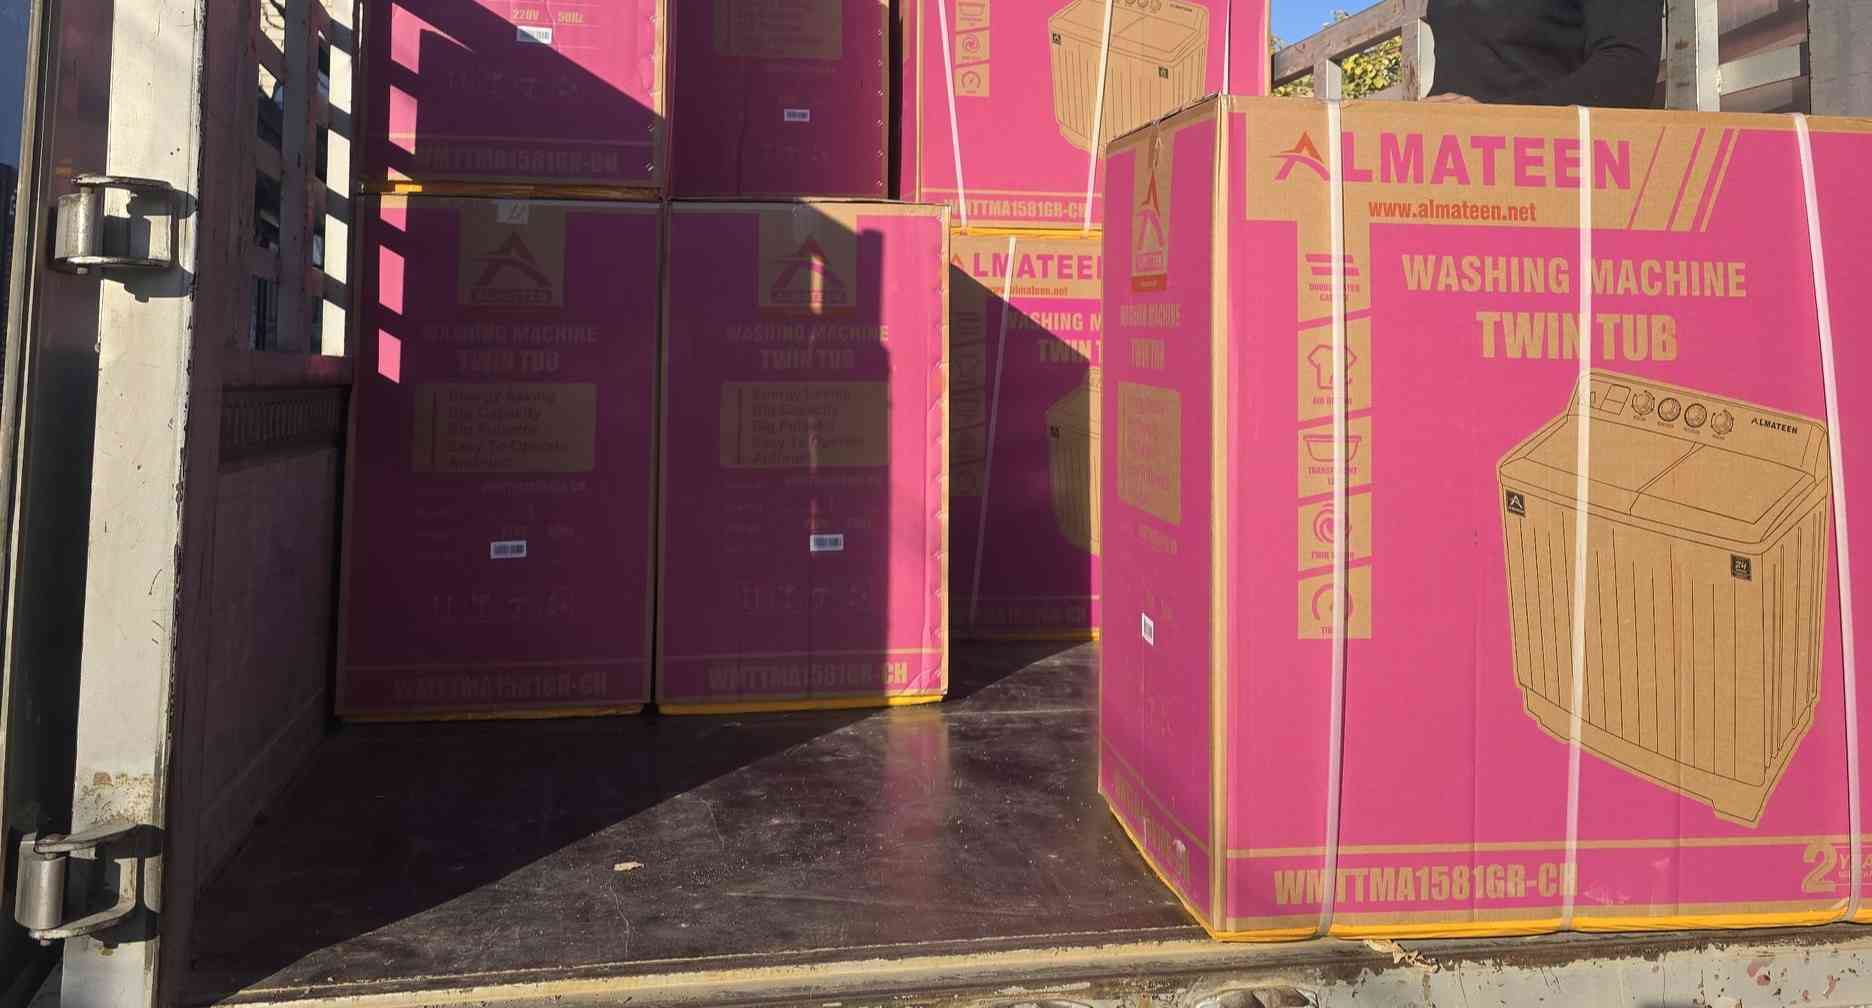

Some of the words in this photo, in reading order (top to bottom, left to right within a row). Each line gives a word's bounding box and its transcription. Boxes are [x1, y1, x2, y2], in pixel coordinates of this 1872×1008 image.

[1270, 130, 1632, 190] ALMATEEN
[1369, 199, 1537, 222] www.almateen.net
[951, 251, 1102, 280] LMATEE
[1401, 254, 1569, 294] WASHING
[1589, 258, 1747, 297] MACHINE
[1476, 310, 1583, 361] TWIN
[1597, 313, 1678, 361] TUB
[1751, 417, 1798, 434] ALMATEEN
[1802, 838, 1837, 894] 2
